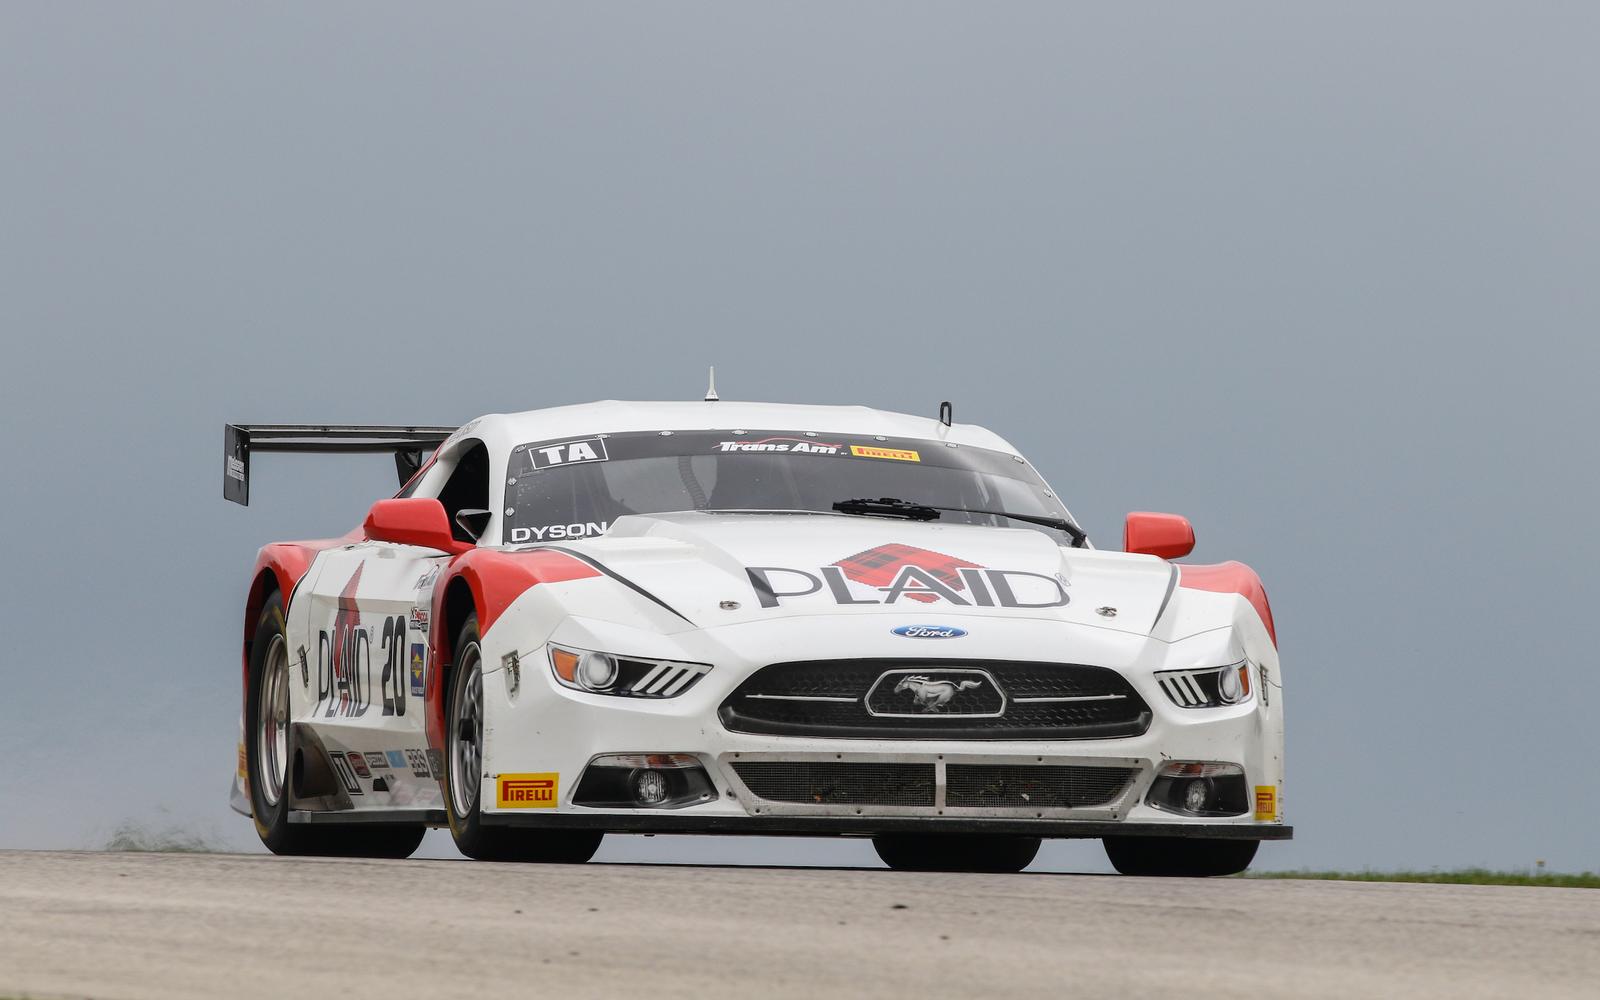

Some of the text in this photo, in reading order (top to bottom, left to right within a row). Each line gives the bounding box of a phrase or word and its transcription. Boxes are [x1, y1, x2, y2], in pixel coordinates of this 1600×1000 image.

[538, 442, 598, 465] TA
[719, 441, 789, 452] Trans
[790, 442, 837, 454] Am
[511, 521, 607, 542] DYSON
[745, 564, 1071, 609] PLAID
[905, 626, 955, 637] Ford
[312, 624, 371, 718] PLAID
[381, 615, 406, 717] 20
[502, 780, 554, 802] PIRELLI
